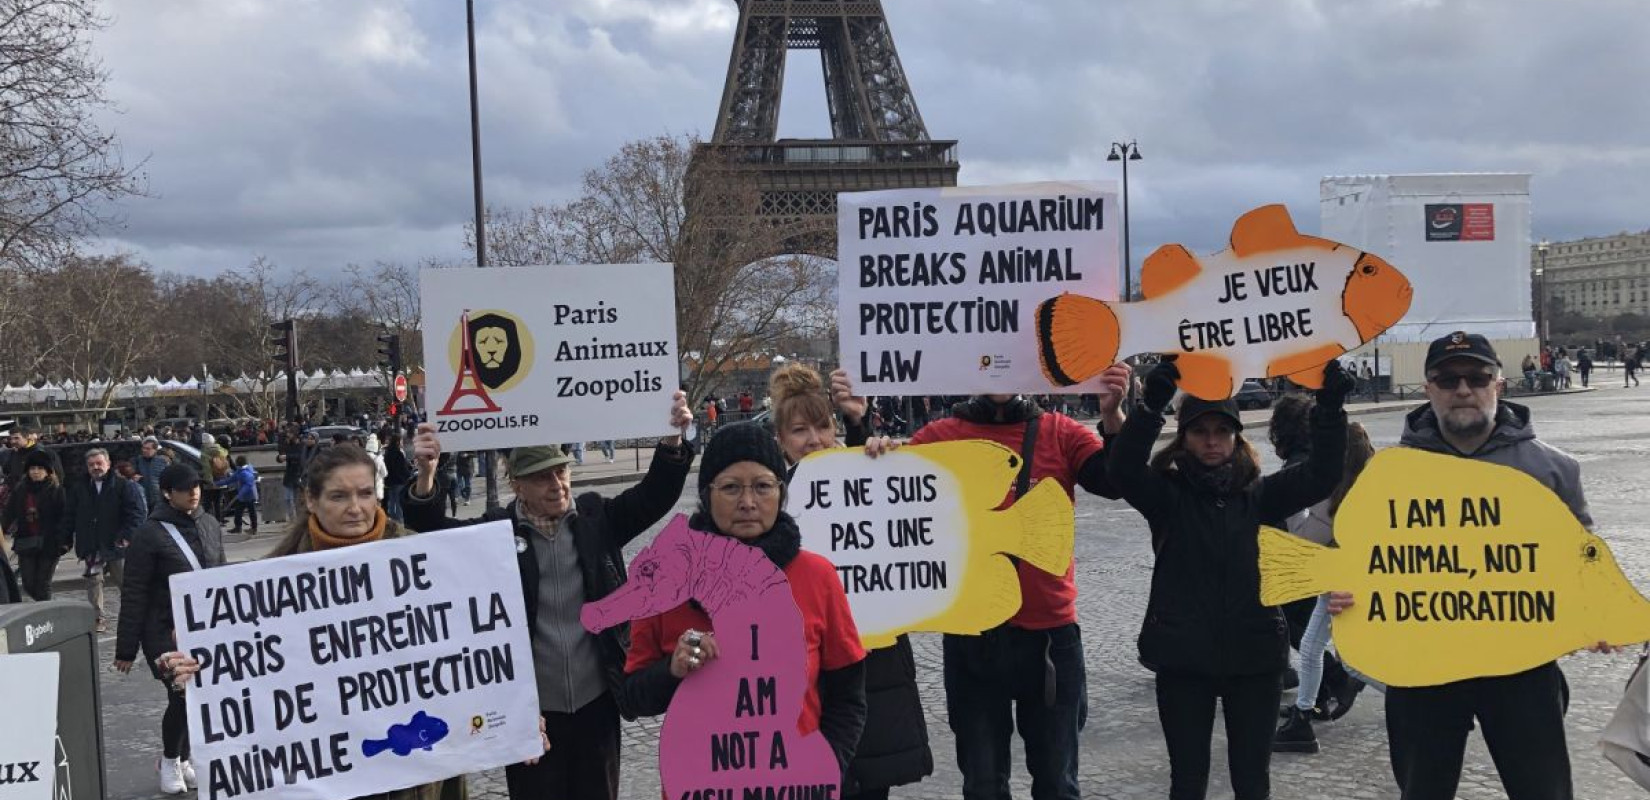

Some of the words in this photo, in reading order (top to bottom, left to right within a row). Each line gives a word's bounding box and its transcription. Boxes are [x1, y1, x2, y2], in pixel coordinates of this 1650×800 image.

[859, 252, 966, 288] BREAKS
[1218, 271, 1248, 303] JE
[1253, 261, 1319, 298] VEUX
[553, 300, 618, 326] Paris
[1178, 318, 1236, 353] ÊTRE
[1243, 308, 1314, 345] LIBRE
[554, 337, 669, 362] Animaux
[860, 350, 922, 383] LAW
[556, 369, 663, 402] Zoopolis
[437, 414, 539, 434] ZOOPOLIS.FR
[804, 479, 833, 510] JE
[843, 477, 874, 507] NE
[886, 473, 937, 504] SUIS
[1388, 498, 1398, 529] I
[1406, 498, 1446, 529] AM
[1459, 496, 1501, 528] AN
[830, 520, 875, 552] PAS
[887, 516, 935, 548] UNE
[388, 553, 432, 597] DE
[835, 560, 948, 595] TRACTION
[1367, 544, 1478, 579] ANIMAL,
[1484, 542, 1539, 574] NOT
[468, 592, 512, 635] LA
[1367, 591, 1387, 622] A
[1395, 590, 1555, 623] DECORATION
[750, 623, 759, 661] I
[273, 681, 319, 731] DE
[735, 676, 777, 718] AM
[711, 730, 760, 772] NOT
[769, 730, 789, 770] A
[0, 761, 40, 784] ux
